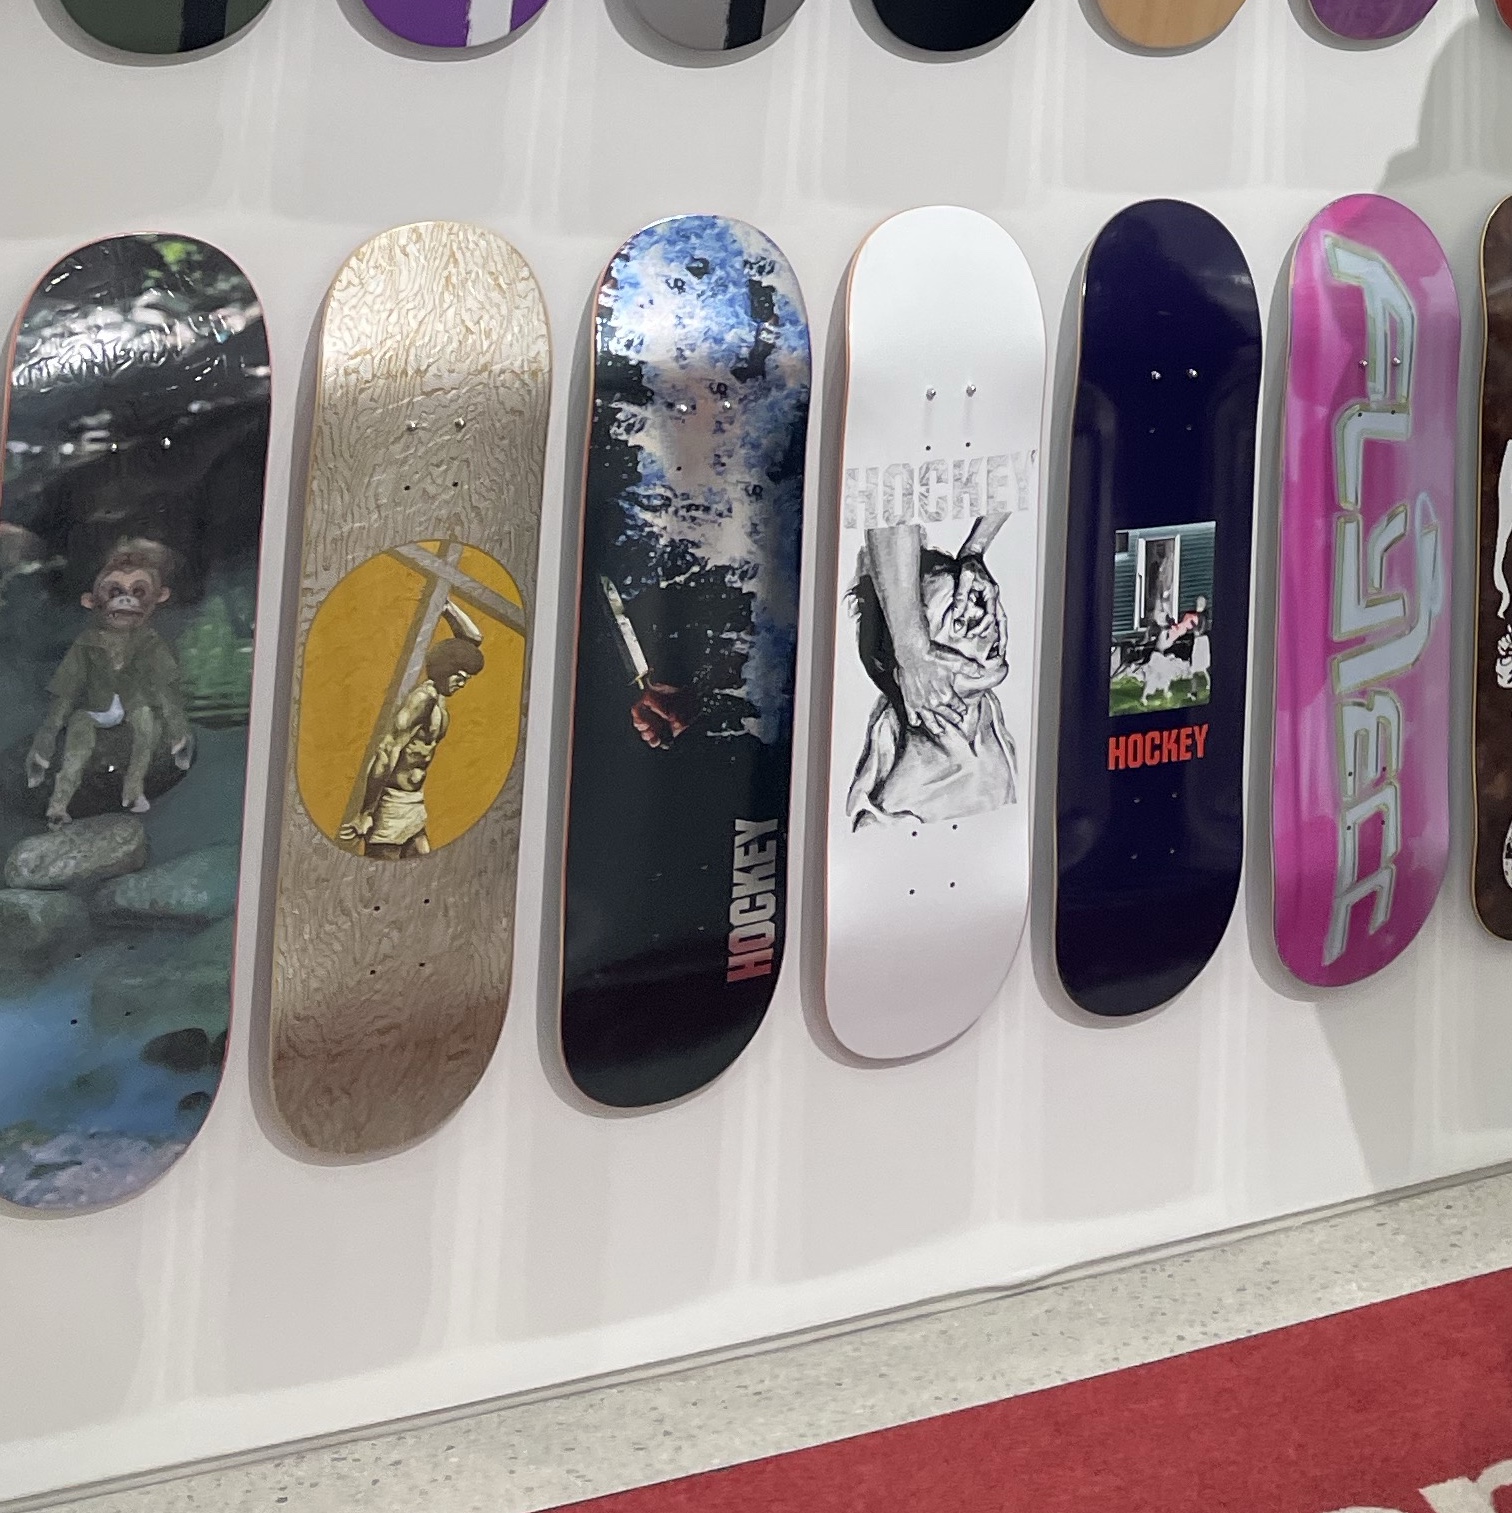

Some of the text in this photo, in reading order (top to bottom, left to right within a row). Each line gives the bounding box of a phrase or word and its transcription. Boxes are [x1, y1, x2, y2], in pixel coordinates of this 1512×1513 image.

[843, 449, 1037, 529] HOCKEY
[1107, 724, 1209, 771] HOCKEY
[726, 818, 779, 983] HOCKEY
